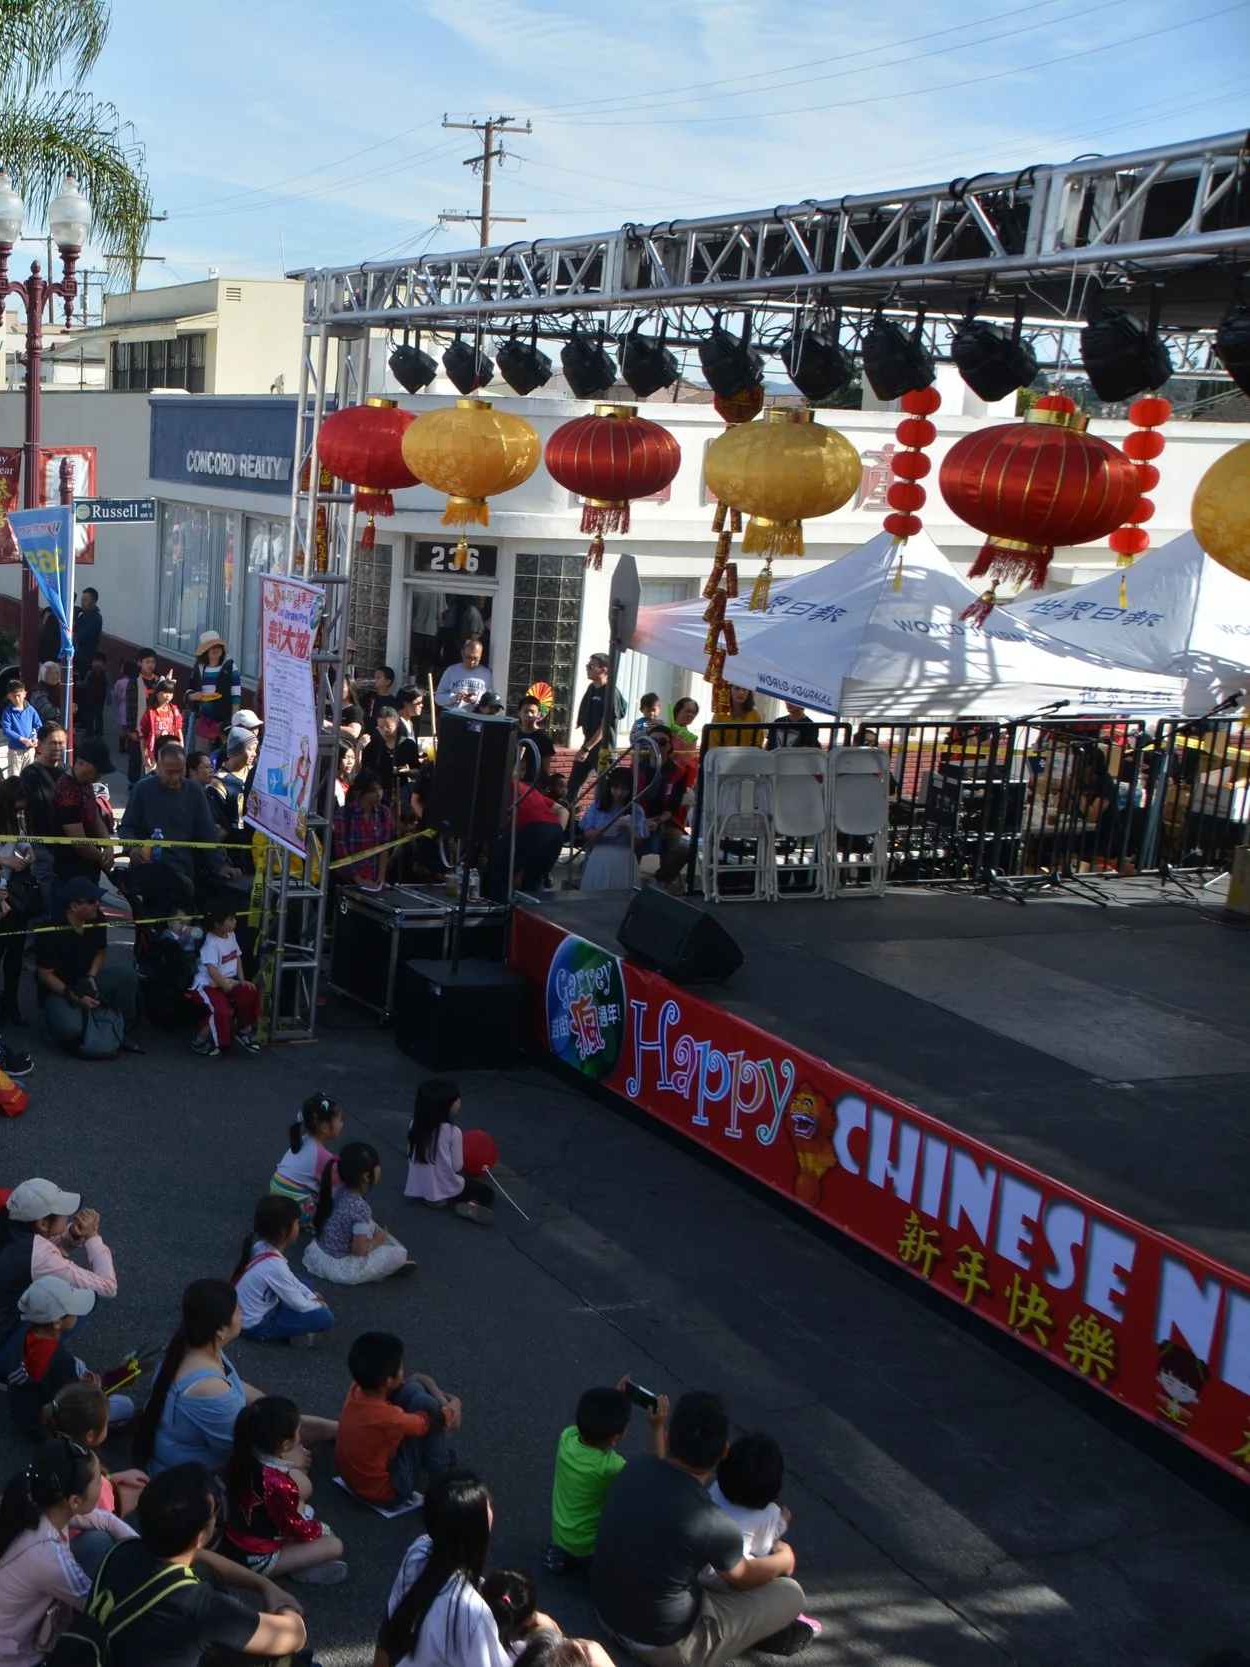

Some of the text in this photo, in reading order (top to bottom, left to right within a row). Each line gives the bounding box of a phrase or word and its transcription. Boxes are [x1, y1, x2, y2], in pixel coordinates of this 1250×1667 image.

[186, 450, 283, 481] CONCORD REALTY
[92, 504, 138, 518] Russell
[1028, 598, 1164, 627] 世界日報
[894, 619, 966, 637] WORLD
[1215, 622, 1250, 636] WO
[757, 671, 789, 692] WORLD
[555, 961, 612, 1009] Garvey
[626, 999, 795, 1146] Happy
[833, 1094, 1136, 1325] CHINESE
[898, 1210, 1116, 1382] 新年快樂
